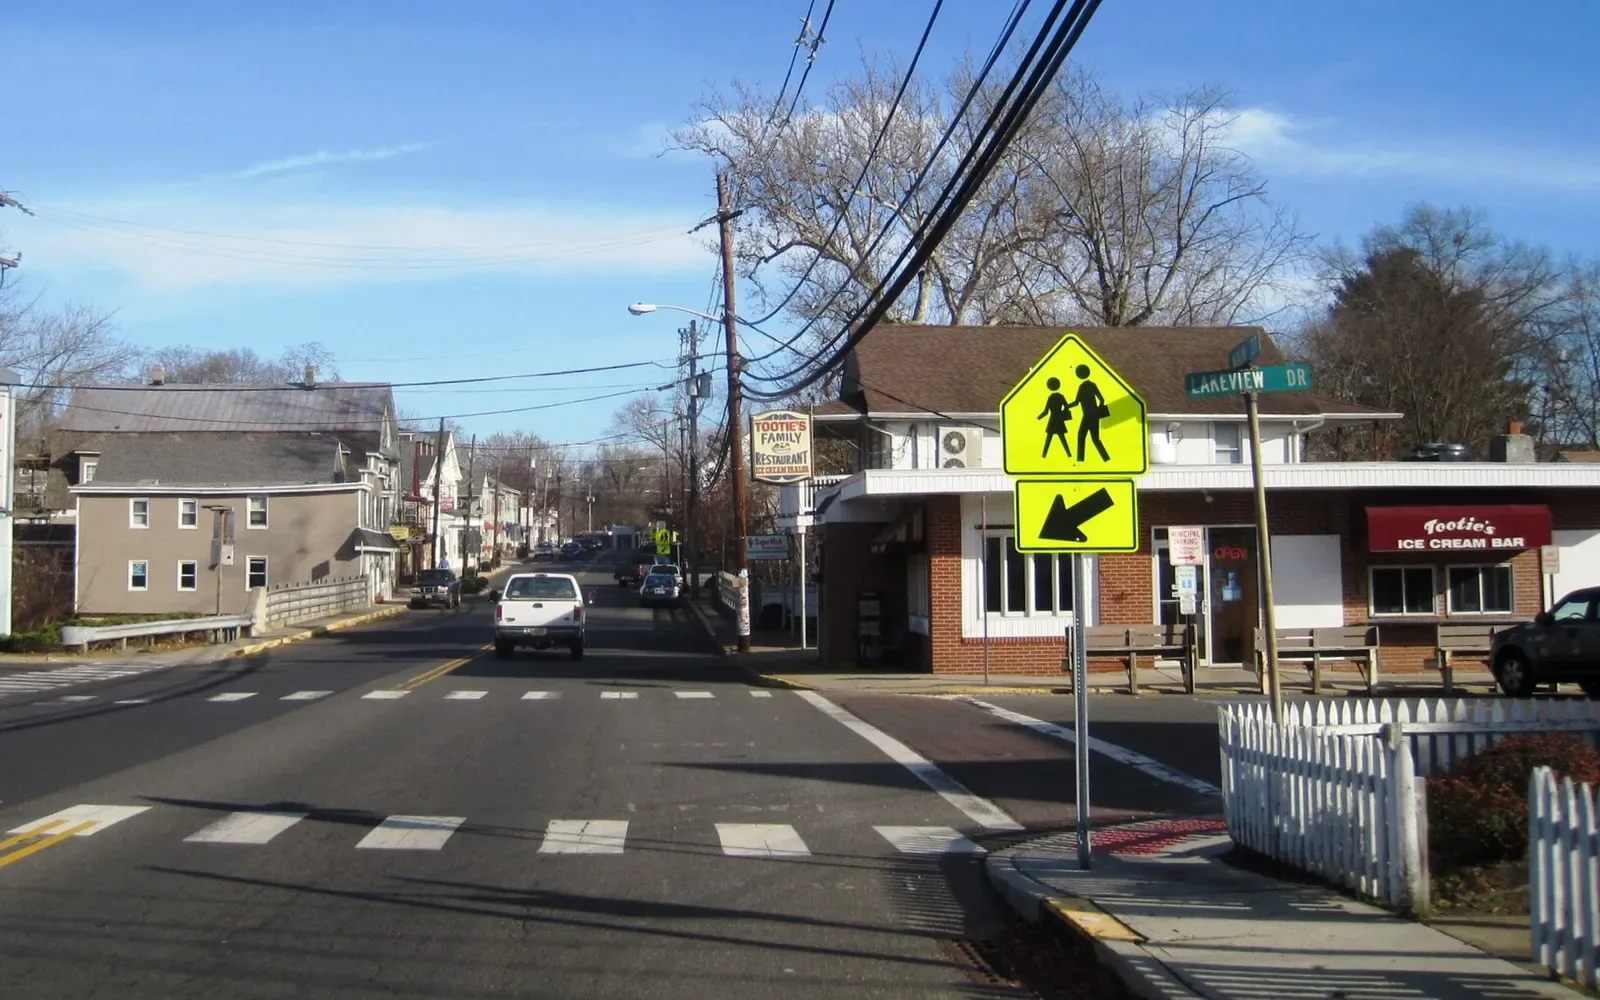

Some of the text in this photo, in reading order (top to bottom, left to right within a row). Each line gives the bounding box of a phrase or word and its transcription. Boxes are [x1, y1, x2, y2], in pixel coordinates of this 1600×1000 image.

[1191, 369, 1307, 395] LAKEVIEW DR
[755, 421, 807, 432] TOOTIE'S
[761, 433, 802, 445] FAMILY
[755, 451, 808, 465] RESTAURANT
[756, 466, 764, 474] ICE
[766, 466, 786, 474] CREAM
[1424, 517, 1496, 535] Tootie's
[1171, 530, 1200, 538] MUNICIPAL
[1398, 537, 1524, 549] ICE CREAM BAR
[1214, 547, 1247, 560] OPEN
